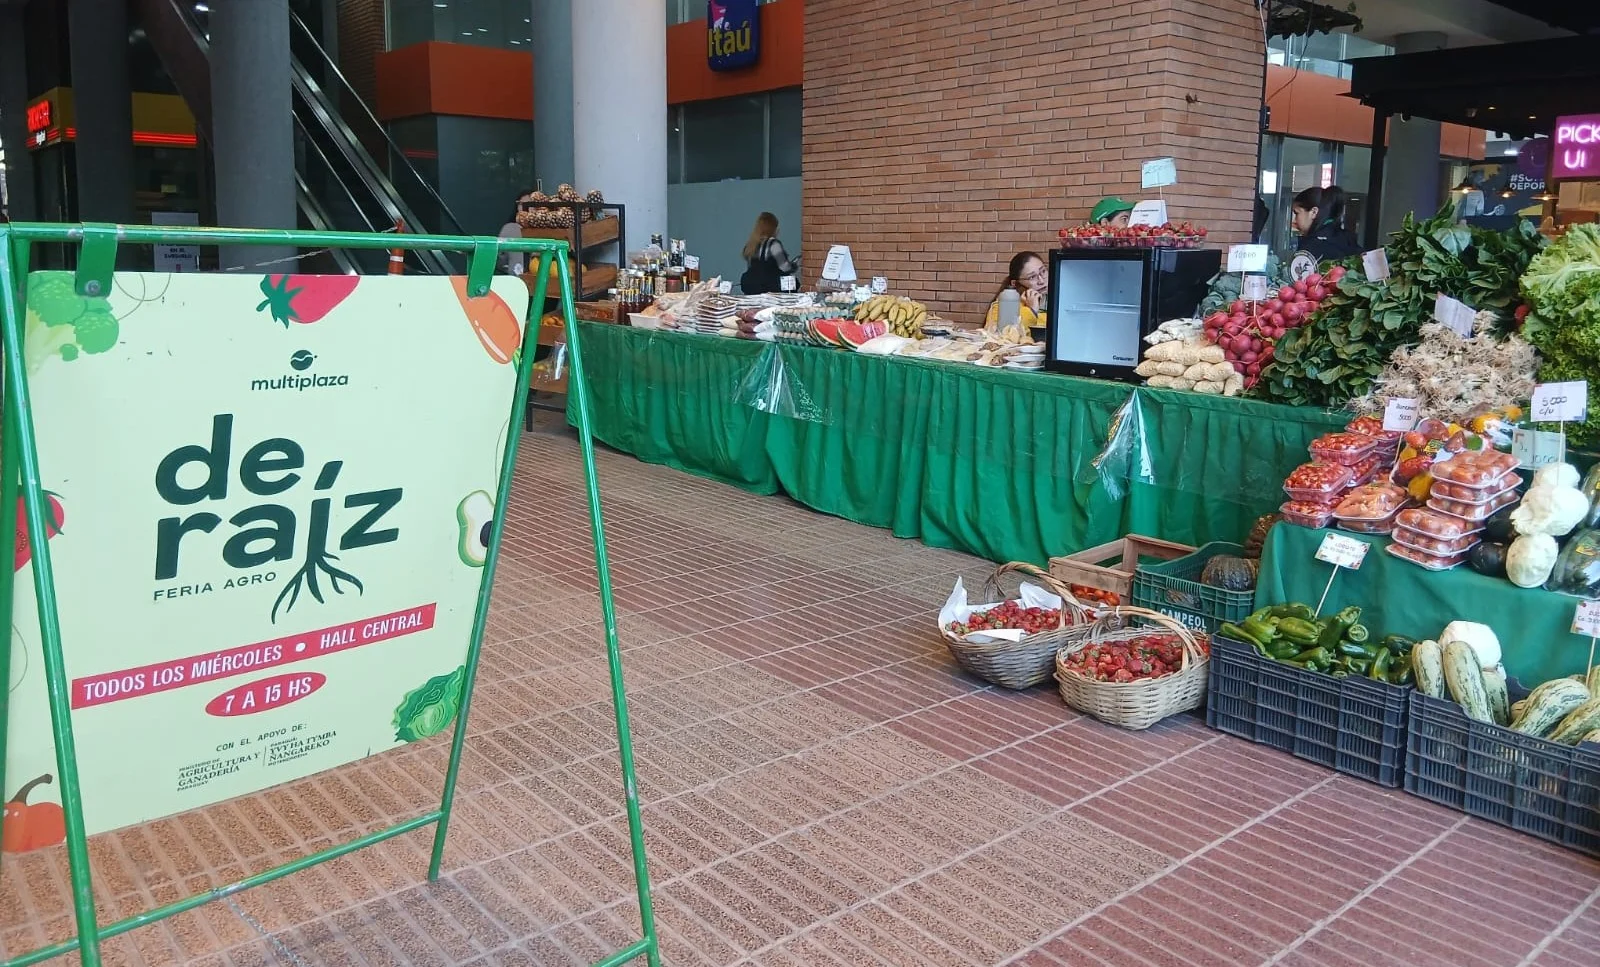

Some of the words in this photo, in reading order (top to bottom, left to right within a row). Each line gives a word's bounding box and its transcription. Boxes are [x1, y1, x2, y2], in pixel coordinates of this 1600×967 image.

[709, 20, 750, 57] Itaú
[251, 374, 349, 391] multiplaza
[155, 413, 305, 505] de
[155, 460, 403, 606] raíz
[153, 582, 213, 601] FERIA
[224, 571, 277, 590] AGRO
[84, 673, 145, 701] TODOS
[153, 665, 185, 687] LOS
[191, 644, 283, 680] MIÉRCOLES
[319, 627, 356, 650] HALL
[362, 609, 424, 640] CENTRAL
[223, 695, 235, 714] 7
[242, 690, 256, 710] A
[265, 684, 282, 705] 15
[288, 675, 312, 698] HS
[216, 741, 235, 752] CON
[240, 737, 252, 747] EL
[257, 728, 287, 742] APOYO
[178, 755, 252, 779] AGRICULTURA
[253, 751, 261, 760] Y
[178, 764, 240, 787] GANADERÍA
